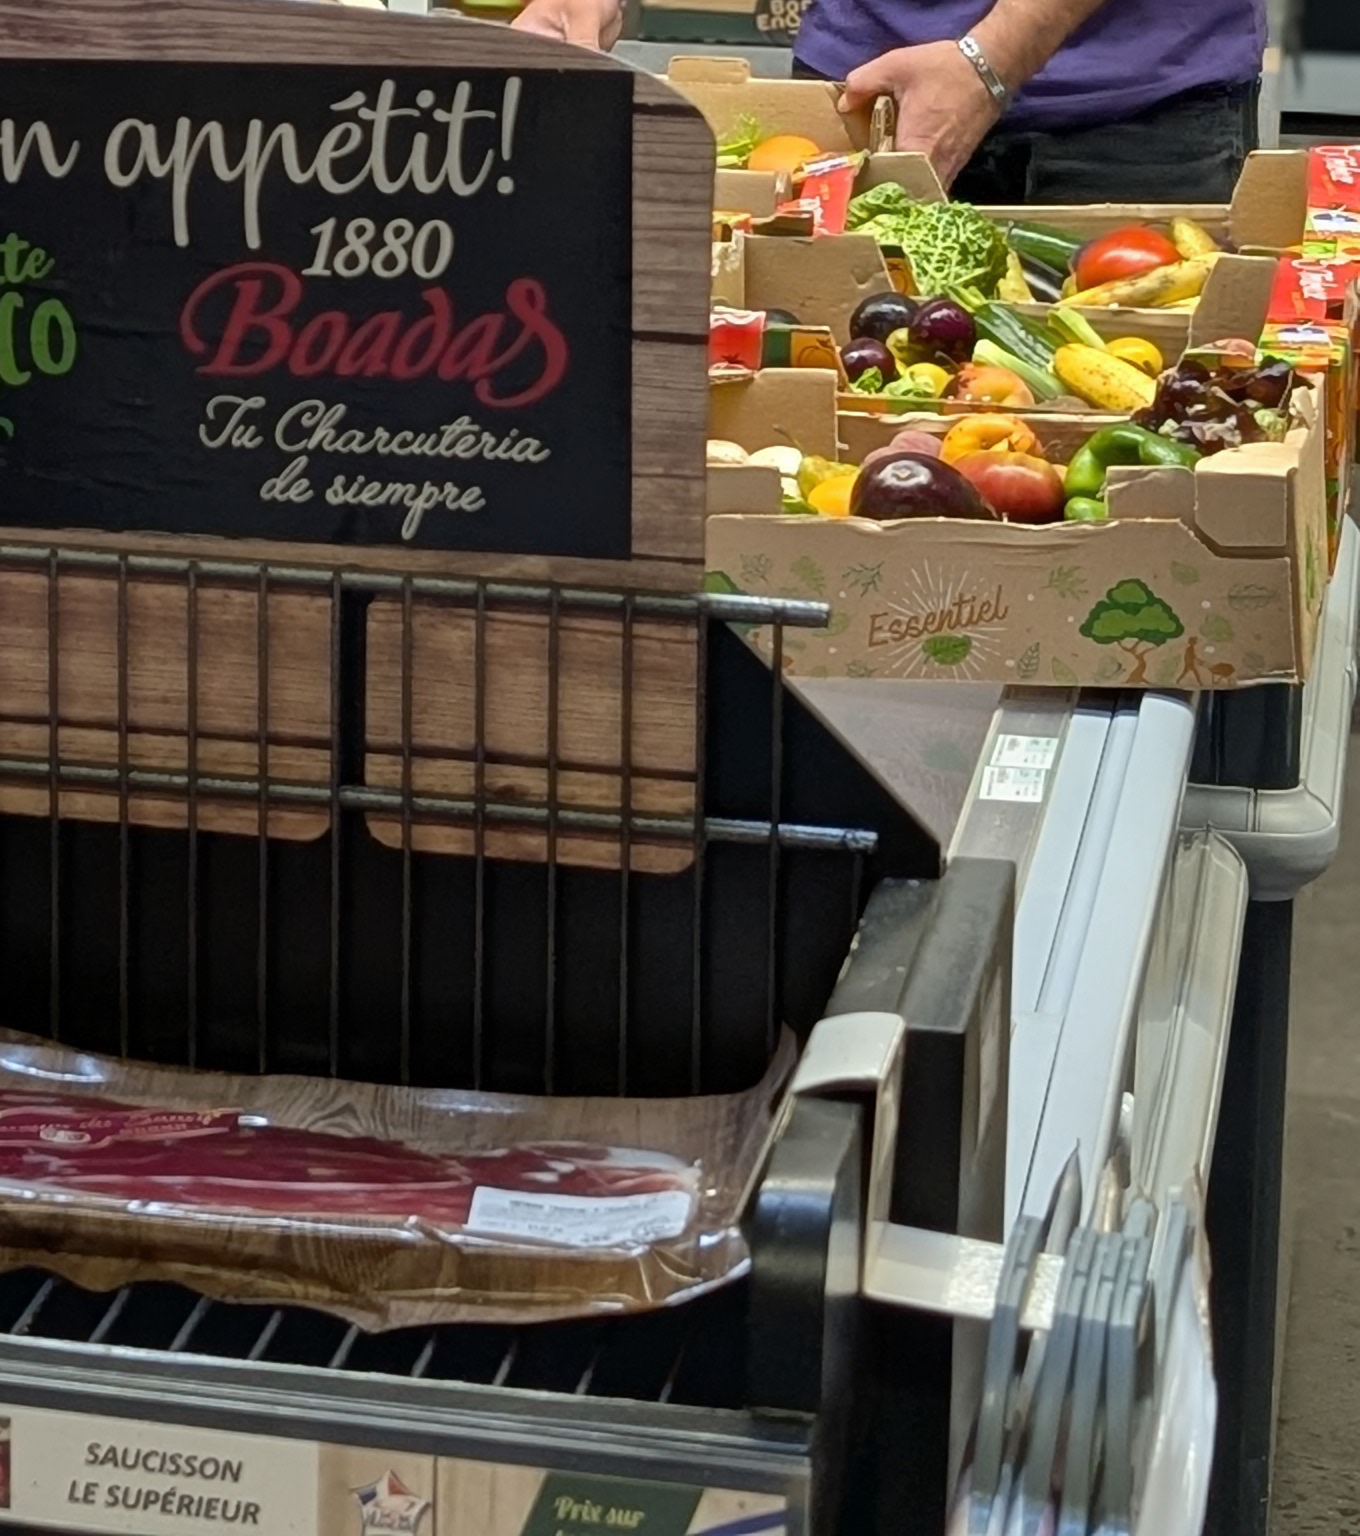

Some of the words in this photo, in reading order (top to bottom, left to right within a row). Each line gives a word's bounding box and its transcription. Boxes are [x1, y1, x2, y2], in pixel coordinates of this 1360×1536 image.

[102, 76, 521, 251] appétit!
[299, 217, 455, 279] 1880
[198, 394, 264, 448] Tu
[273, 398, 551, 465] Charcuteria
[258, 462, 315, 505] de
[325, 469, 488, 539] siempre
[867, 585, 1009, 649] Essentiel
[84, 1442, 244, 1484] SAUCISSON
[67, 1478, 98, 1506] LE
[104, 1484, 262, 1526] SUPÉRIEUR
[554, 1495, 603, 1518] Prix
[604, 1505, 646, 1528] sur
